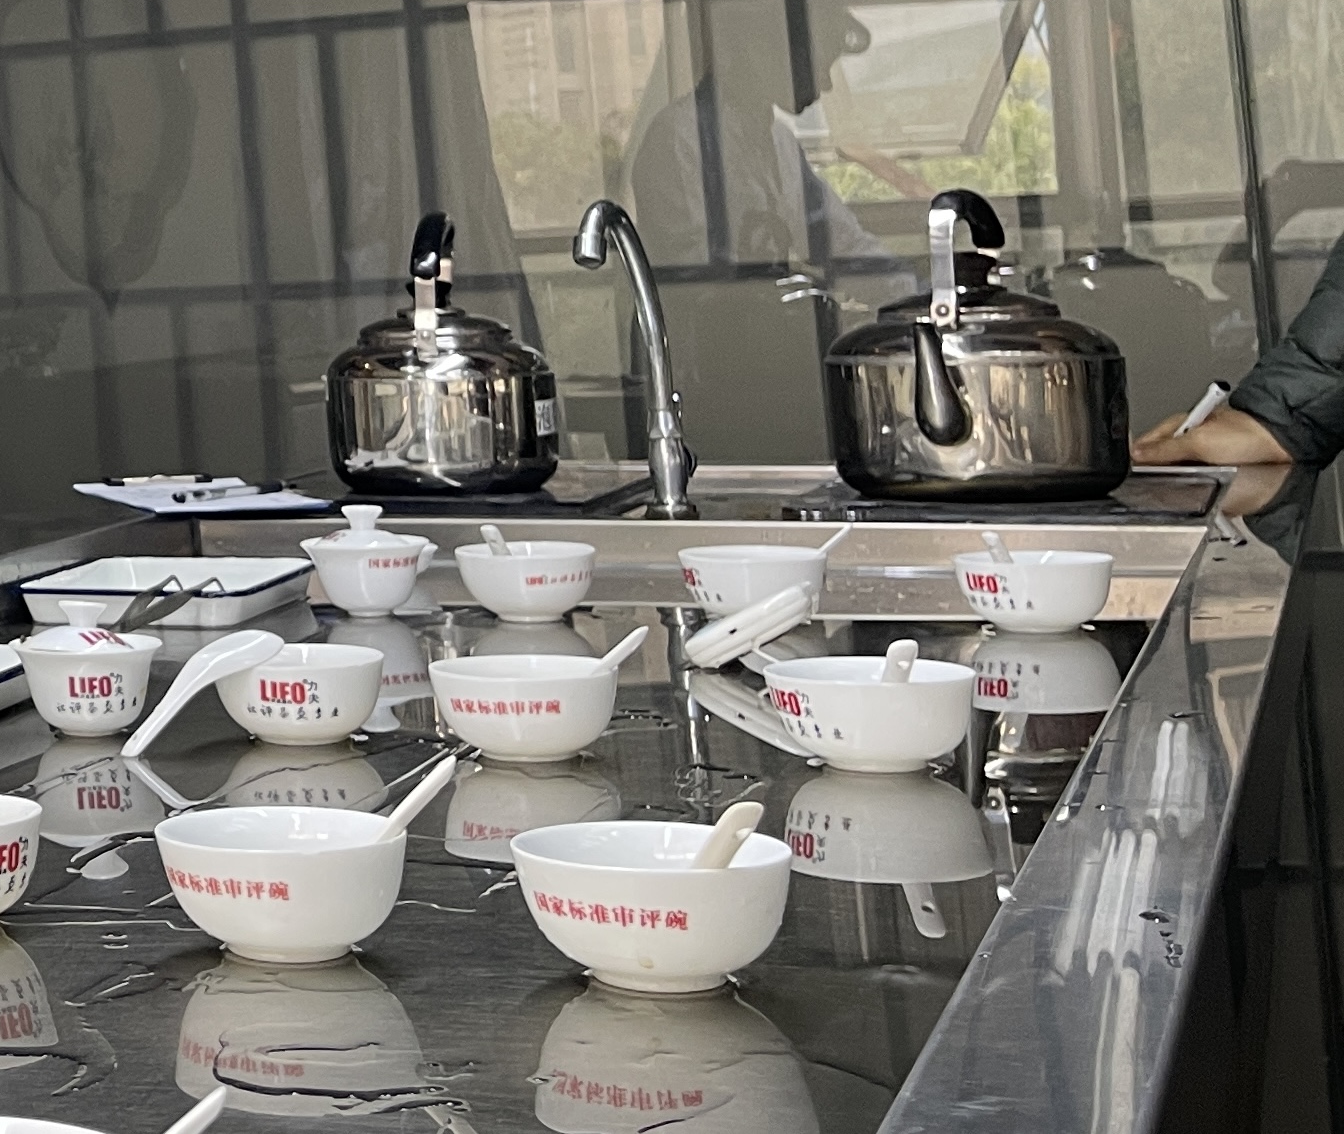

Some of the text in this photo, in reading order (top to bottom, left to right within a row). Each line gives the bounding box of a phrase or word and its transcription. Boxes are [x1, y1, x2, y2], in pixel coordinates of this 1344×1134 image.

[965, 572, 999, 594] LIFO
[68, 675, 113, 698] LIFO
[259, 678, 306, 705] LIFO
[533, 890, 689, 931] 国家标准审评碗
